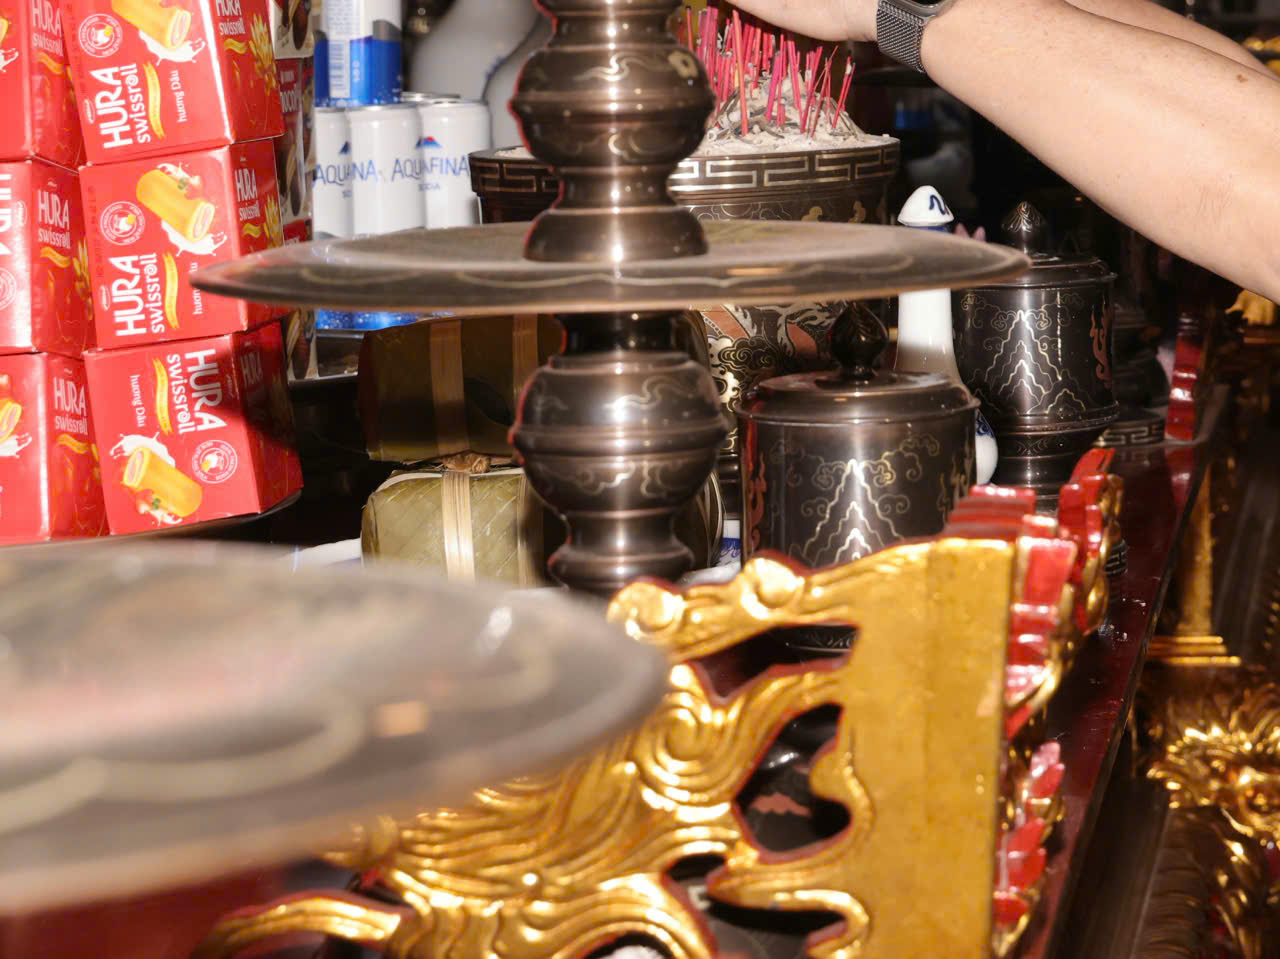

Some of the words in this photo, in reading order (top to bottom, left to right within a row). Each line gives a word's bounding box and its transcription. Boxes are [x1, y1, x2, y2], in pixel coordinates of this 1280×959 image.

[89, 64, 135, 150] HURA
[234, 168, 258, 202] HURA
[38, 189, 70, 230] HURA
[108, 254, 147, 337] HURA
[192, 288, 203, 315] hươn
[54, 376, 86, 416] HURA
[185, 349, 228, 431] HURA
